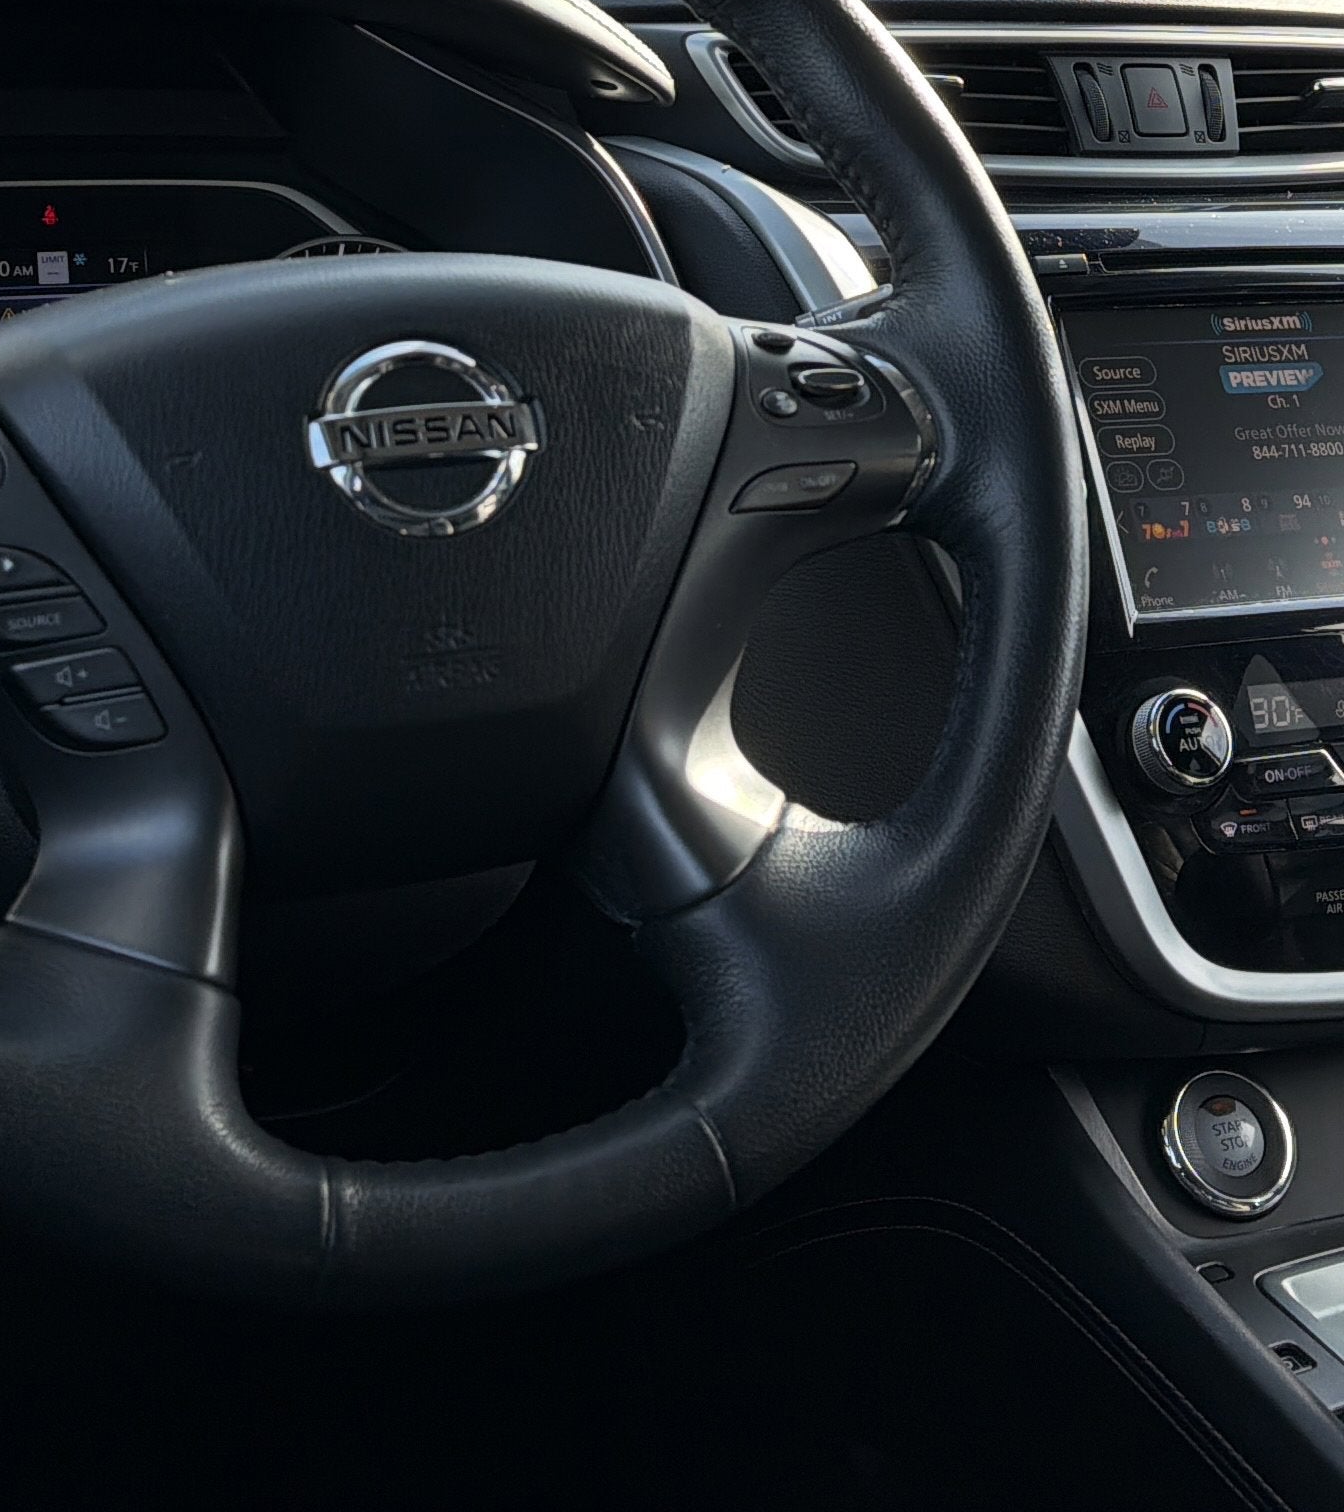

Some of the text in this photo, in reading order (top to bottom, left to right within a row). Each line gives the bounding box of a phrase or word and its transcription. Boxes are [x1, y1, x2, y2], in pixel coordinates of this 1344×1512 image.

[41, 256, 64, 264] LIMIT
[13, 265, 34, 276] AM
[822, 312, 843, 324] INT
[1222, 344, 1309, 363] SIRIUSXM
[1093, 366, 1141, 380] Source
[1228, 369, 1315, 387] PREVIEW
[1094, 399, 1159, 414] SXM Menu
[1267, 395, 1290, 409] Ch.
[340, 411, 519, 454] NISSAN
[1234, 426, 1274, 440] Great
[1276, 424, 1311, 438] Offer
[1115, 433, 1155, 451] Replay
[1252, 441, 1344, 460] 844-711-8800
[1180, 501, 1190, 516] 7
[1241, 497, 1252, 512] 8
[1293, 494, 1312, 509] 94
[1141, 596, 1174, 607] Phone
[1241, 822, 1271, 834] FRONT
[1326, 902, 1344, 915] AIR
[1222, 1152, 1258, 1171] ENGINE
